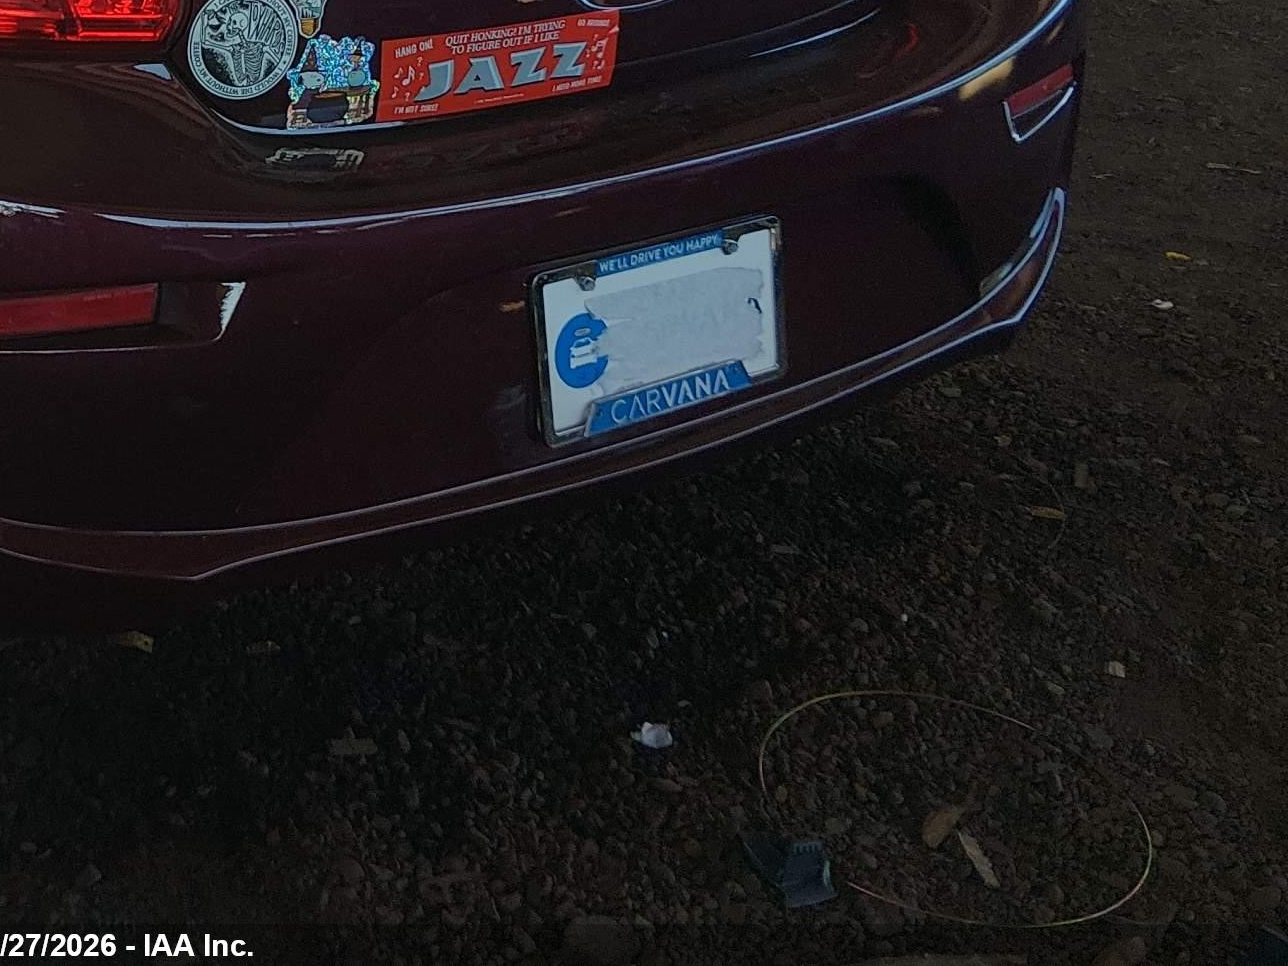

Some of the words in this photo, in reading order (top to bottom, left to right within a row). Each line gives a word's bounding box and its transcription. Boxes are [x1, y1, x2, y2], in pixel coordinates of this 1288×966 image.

[445, 33, 470, 47] QUIT
[470, 27, 518, 43] HONKING!
[518, 24, 532, 34] I'M
[533, 19, 566, 33] TRYING
[451, 44, 465, 55] TO
[466, 39, 501, 54] FIGURE
[502, 36, 523, 48] OUT
[523, 35, 534, 46] IF
[534, 33, 540, 44] I
[540, 30, 561, 43] LIKE
[394, 43, 417, 59] HANG
[254, 71, 281, 91] WOULD
[413, 41, 587, 102] JAZZ
[205, 76, 239, 95] WITHOUT
[240, 87, 253, 95] DIE
[598, 258, 629, 273] WE'LL
[630, 248, 662, 267] DRIVE
[662, 243, 686, 258] YOU
[611, 368, 731, 425] CARVANA
